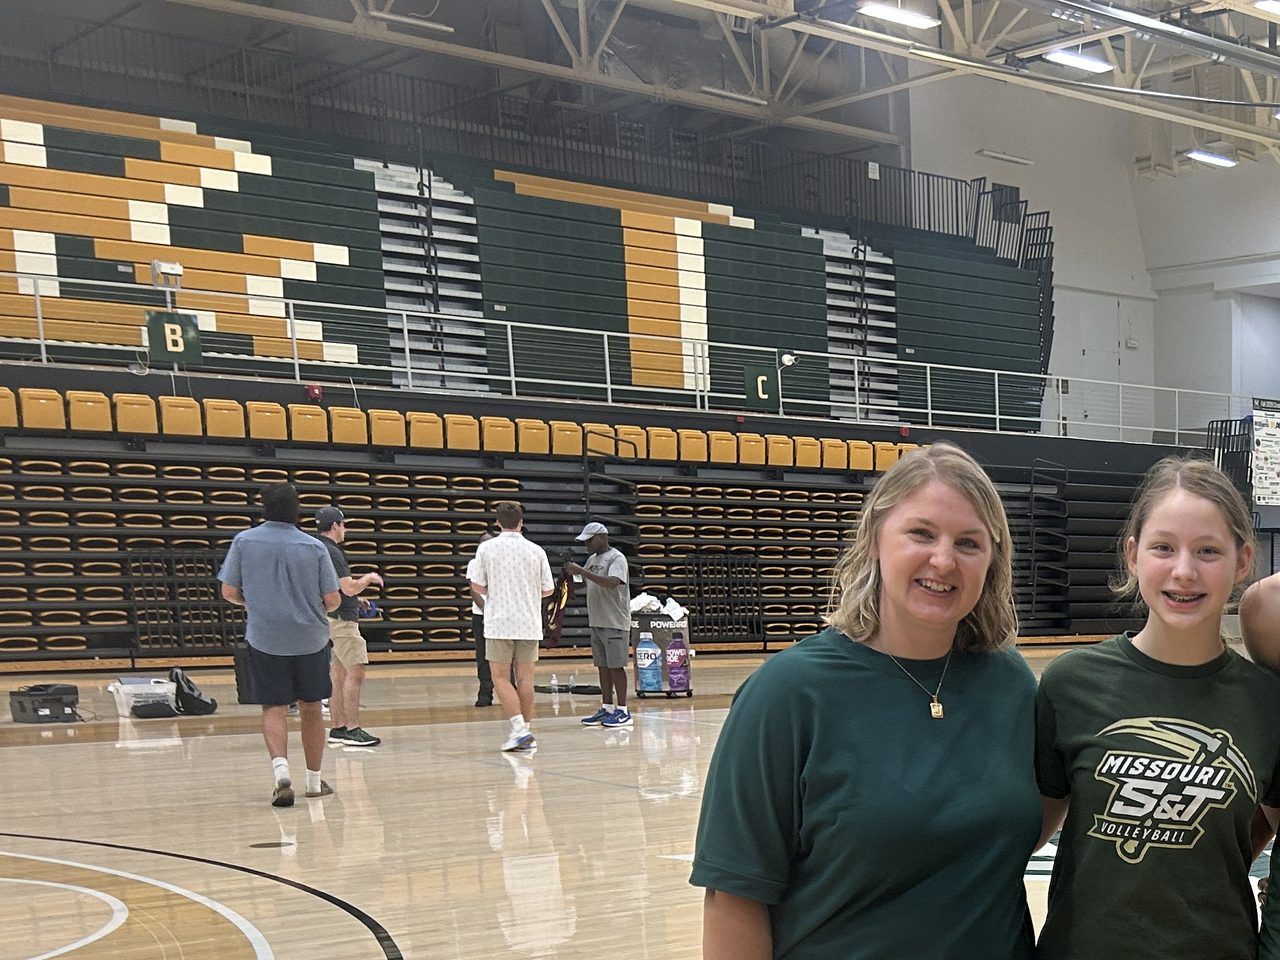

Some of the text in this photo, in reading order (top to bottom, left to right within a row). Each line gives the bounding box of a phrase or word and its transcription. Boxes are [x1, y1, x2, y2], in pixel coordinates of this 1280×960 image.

[164, 323, 185, 352] B
[757, 375, 768, 399] C
[1101, 755, 1225, 788] MISSOURI
[1110, 777, 1225, 822] S&T
[1100, 821, 1185, 843] VOLLEYBALL
